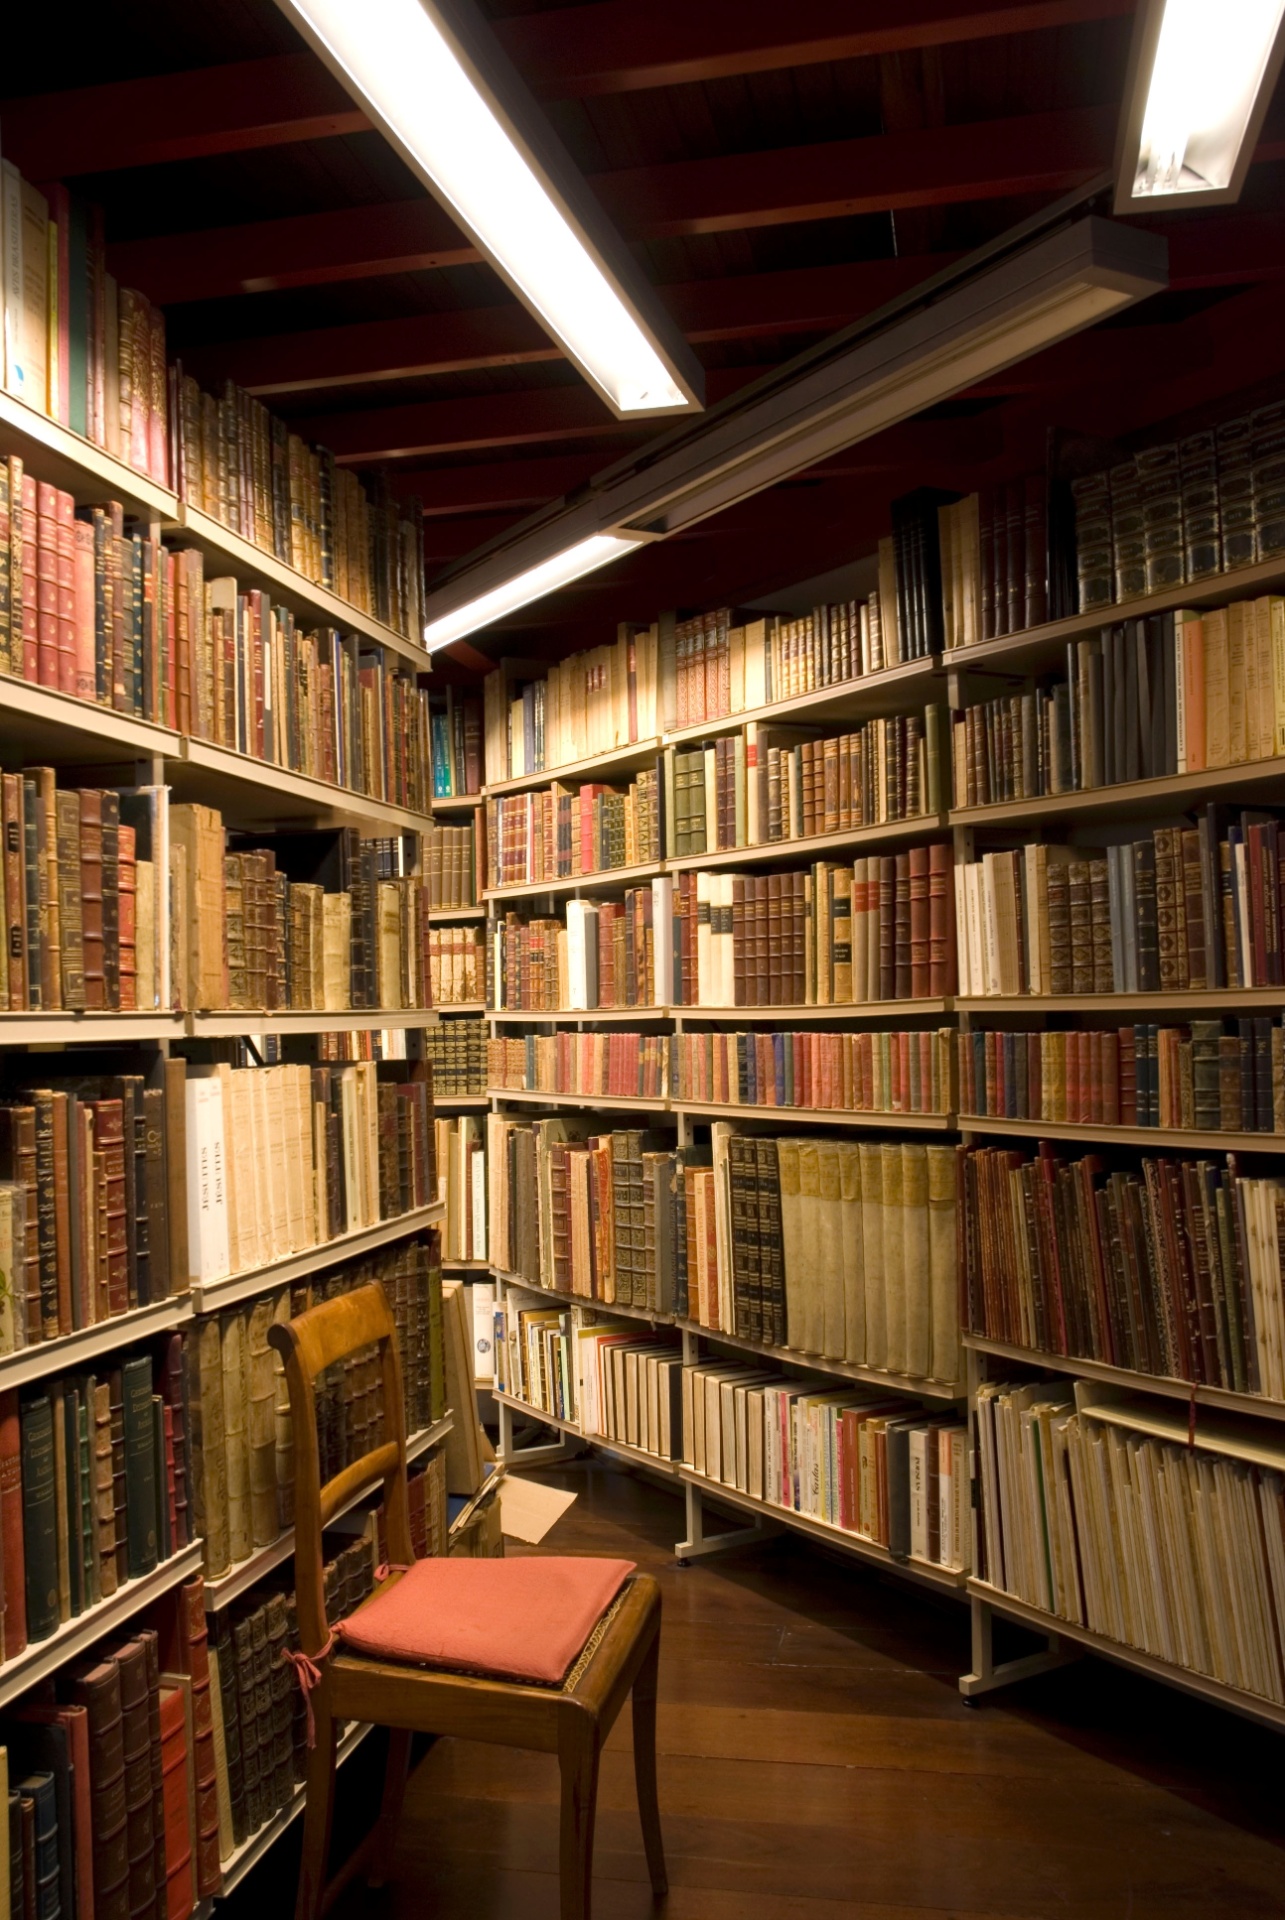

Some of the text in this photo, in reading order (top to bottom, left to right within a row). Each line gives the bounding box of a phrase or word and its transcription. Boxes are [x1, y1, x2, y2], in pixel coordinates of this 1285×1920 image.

[11, 195, 20, 299] AVES BRASILEIRAS
[810, 1463, 820, 1496] Cartas
